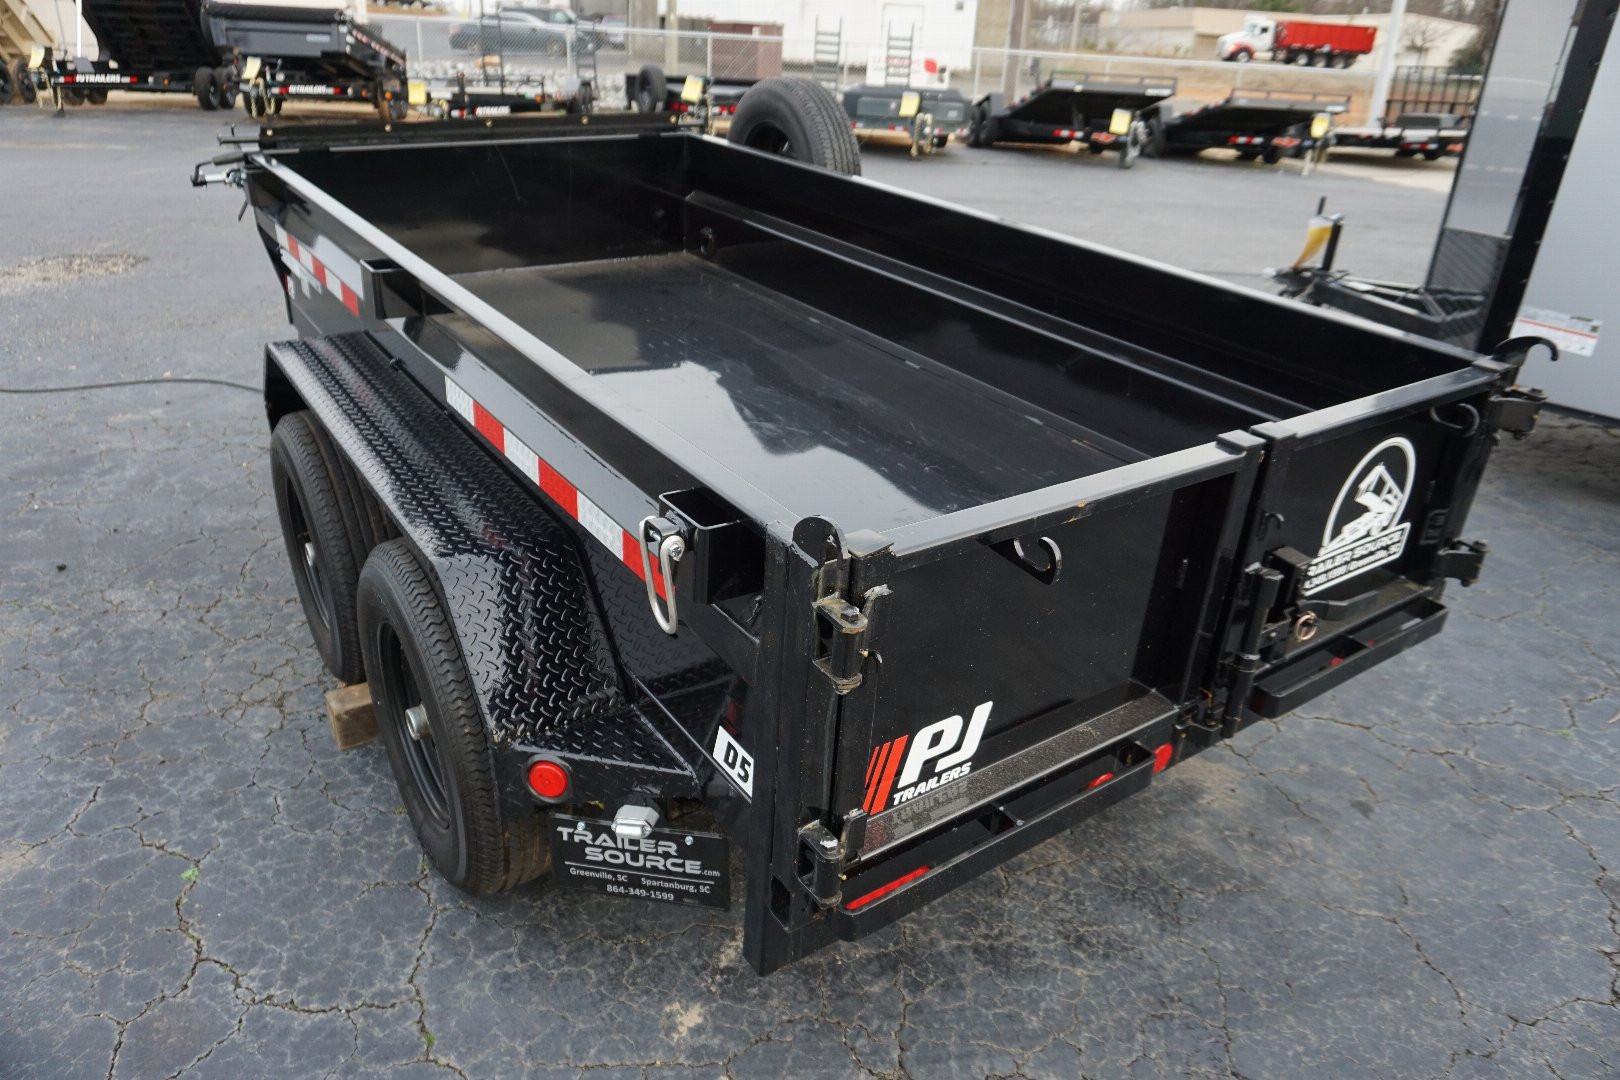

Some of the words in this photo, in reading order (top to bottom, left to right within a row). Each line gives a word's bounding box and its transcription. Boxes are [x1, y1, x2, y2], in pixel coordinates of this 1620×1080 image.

[1306, 551, 1353, 577] RAILER
[1352, 530, 1403, 559] SOURCE
[723, 740, 752, 784] D5
[897, 700, 994, 789] PJ
[893, 761, 972, 806] TRAILERS
[556, 826, 678, 856] TRAILER
[569, 867, 615, 882] Greenville,
[616, 873, 629, 883] SC
[641, 877, 698, 893] Spartanburg,
[699, 885, 712, 895] SC
[606, 884, 675, 901] 864-349-1599
